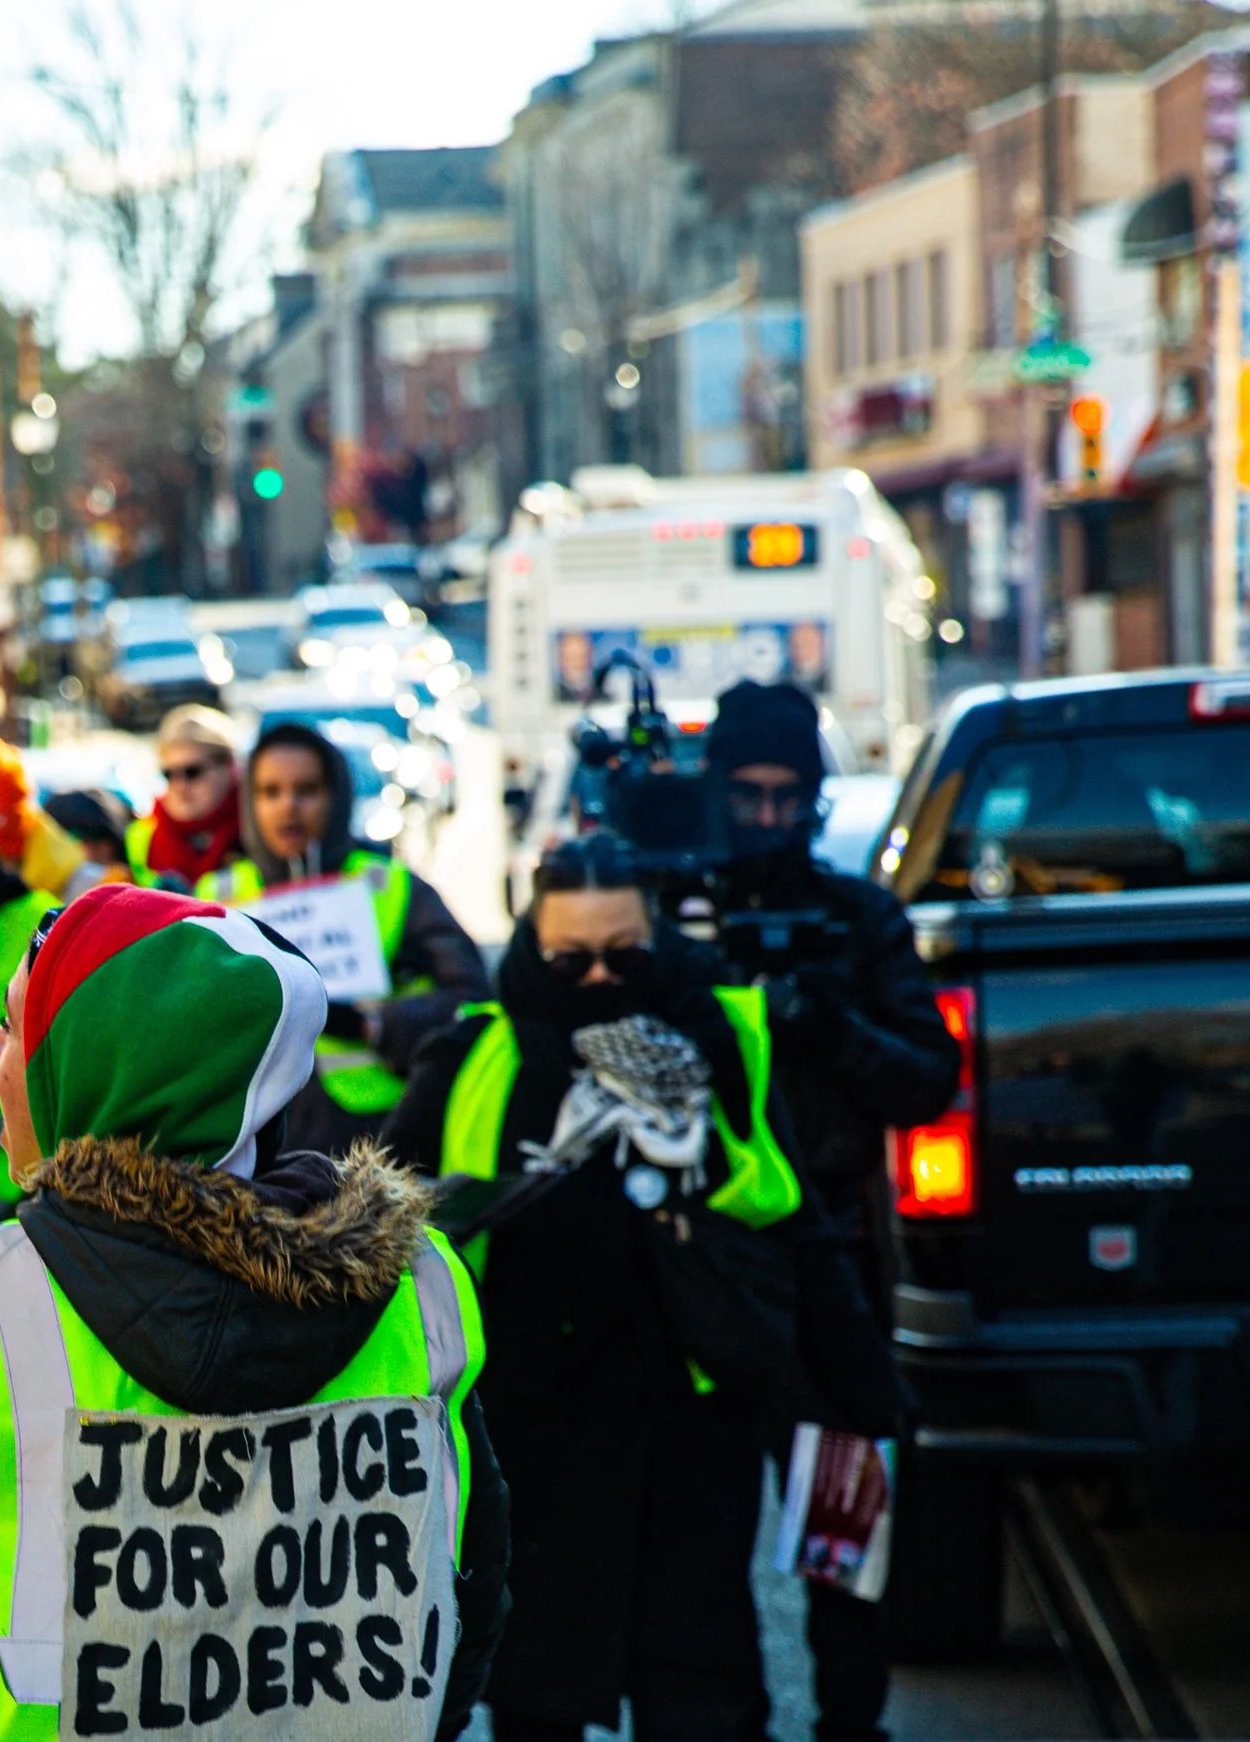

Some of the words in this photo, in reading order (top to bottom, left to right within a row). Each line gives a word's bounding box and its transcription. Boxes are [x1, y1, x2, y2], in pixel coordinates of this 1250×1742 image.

[73, 1408, 427, 1515] JUSTICE
[73, 1523, 228, 1619] FOR
[255, 1512, 418, 1609] OUR
[74, 1604, 440, 1736] ELDERS!
